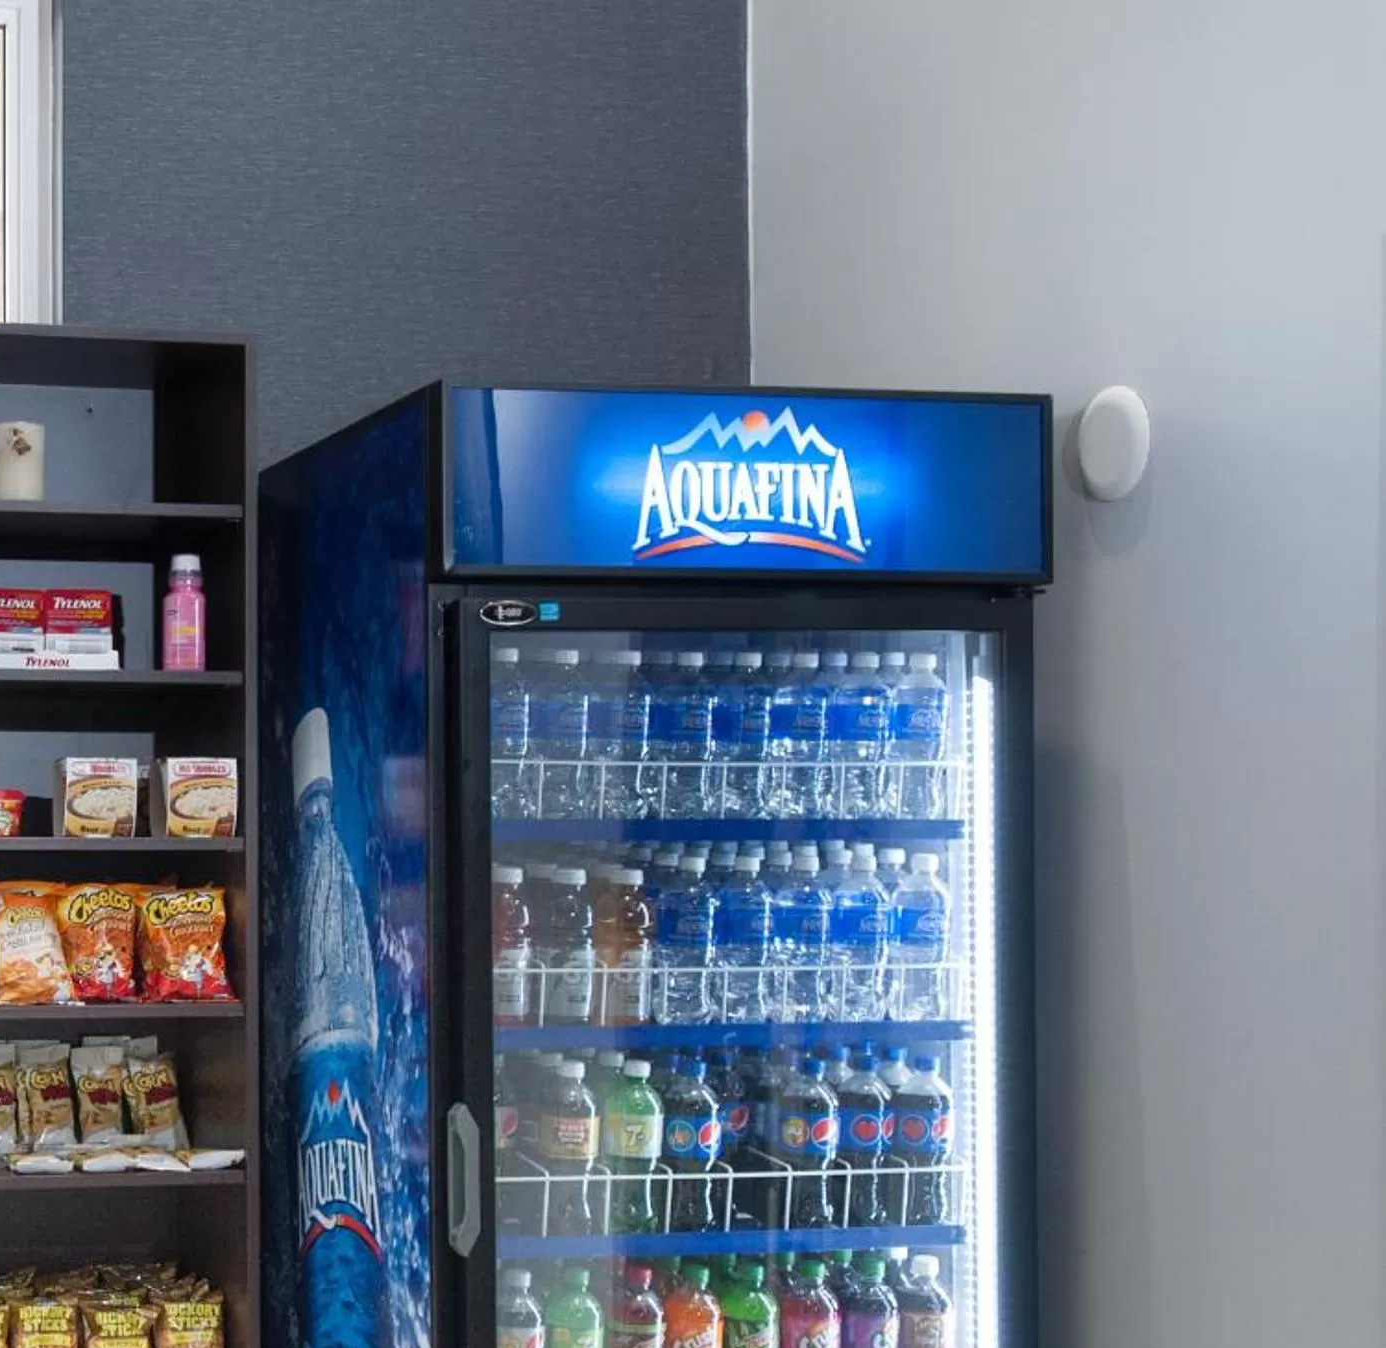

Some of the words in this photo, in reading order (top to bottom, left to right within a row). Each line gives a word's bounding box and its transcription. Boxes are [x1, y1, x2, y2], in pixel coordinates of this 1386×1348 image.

[632, 443, 866, 553] AQUAFINA
[53, 596, 103, 609] TYLENOL
[26, 656, 71, 668] TYLENOL
[68, 889, 132, 924] Cheetos
[147, 892, 214, 926] Cheetos
[298, 1132, 382, 1248] AQUAFINA
